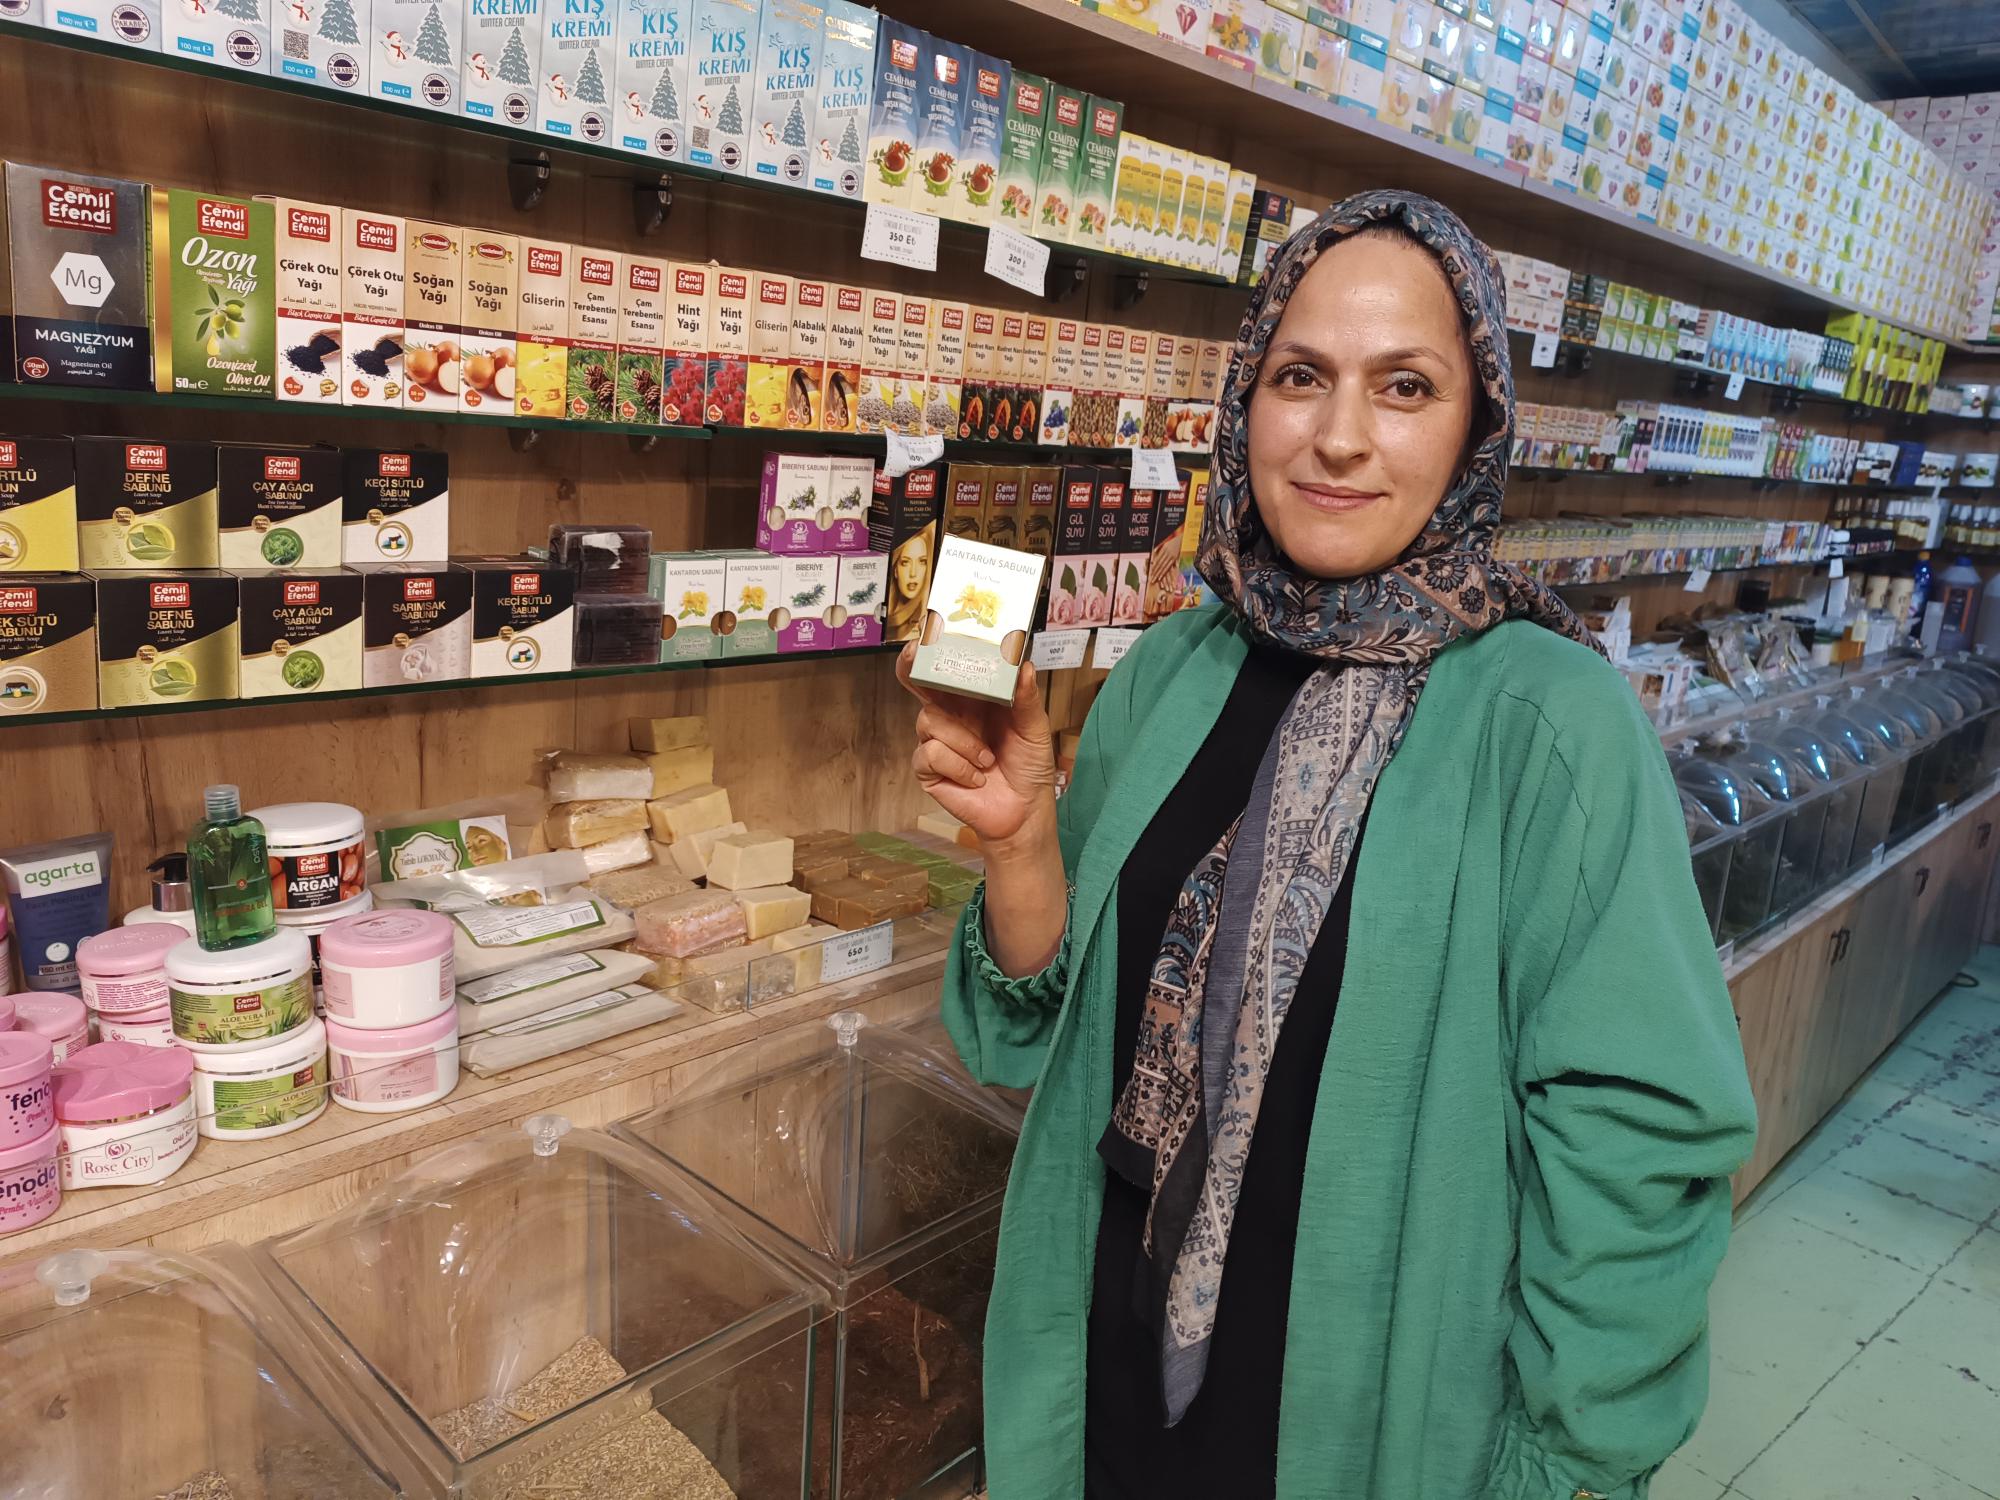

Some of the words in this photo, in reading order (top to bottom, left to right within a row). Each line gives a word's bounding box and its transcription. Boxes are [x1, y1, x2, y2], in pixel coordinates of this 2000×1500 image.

[504, 17, 525, 26] CREAM
[642, 12, 678, 40] KIŞ
[229, 44, 258, 53] PARABEN
[711, 31, 746, 57] KIŞ
[778, 47, 810, 72] KIŞ
[330, 66, 357, 74] PARABEN
[48, 184, 110, 208] Cemil
[49, 203, 111, 225] Efendi
[201, 204, 244, 220] Cemil
[201, 216, 244, 232] Efendi
[292, 212, 327, 225] Cemil
[292, 222, 327, 236] Efendi
[360, 222, 393, 236] Cemil
[360, 233, 393, 246] Efendi
[889, 231, 903, 242] 350
[182, 237, 257, 277] Ozon
[530, 249, 559, 263] Cemil
[280, 259, 315, 273] Çörek
[317, 264, 339, 276] Otu
[530, 259, 560, 272] Efendi
[584, 260, 611, 273] Cemil
[348, 265, 381, 280] Çörek
[383, 270, 404, 282] Otu
[583, 270, 611, 282] Efendi
[633, 267, 658, 279] Cemil
[678, 272, 703, 283] Cemil
[65, 268, 102, 294] Mg
[226, 272, 256, 297] Yağı
[297, 278, 322, 291] Yağı
[413, 272, 454, 288] Soğan
[632, 276, 658, 288] Efendi
[678, 280, 702, 291] Efendi
[721, 276, 745, 287] Cemil
[364, 284, 388, 297] Yağı
[468, 280, 508, 296] Soğan
[721, 284, 744, 296] Efendi
[763, 282, 785, 293] Cemil
[802, 285, 822, 296] Cemil
[419, 289, 447, 303] Yağı
[522, 293, 565, 308] Gliserin
[587, 292, 604, 302] Çam
[762, 290, 784, 301] Efendi
[840, 290, 860, 301] Cemil
[475, 297, 501, 311] Yağı
[573, 302, 617, 315] Terebentin
[636, 299, 652, 308] Çam
[623, 309, 663, 320] Terebentin
[678, 304, 700, 317] Hint
[720, 307, 742, 319] Hint
[582, 315, 607, 326] Esansı
[631, 320, 655, 331] Esansı
[677, 318, 699, 332] Yağı
[755, 319, 788, 332] Gliserin
[793, 320, 826, 332] Alabalık
[720, 321, 741, 334] Yağı
[832, 324, 863, 336] Alabalık
[873, 325, 893, 334] Keten
[35, 328, 134, 348] MAGNEZYUM
[801, 332, 817, 344] Yağı
[903, 329, 923, 339] Keten
[941, 334, 960, 343] Keten
[839, 338, 855, 349] Yağı
[868, 335, 896, 346] Tohumu
[899, 340, 926, 350] Tohumu
[74, 345, 96, 355] YAĞI
[874, 347, 889, 358] Yağı
[937, 344, 962, 354] Tohumu
[904, 351, 919, 361] Yağı
[942, 355, 956, 365] Yağı
[61, 359, 100, 369] Magnesium
[101, 361, 113, 369] Oil
[207, 357, 256, 373] Ozonized
[226, 371, 252, 386] Olive
[253, 373, 271, 386] Oil
[130, 447, 163, 457] Cemil
[130, 456, 163, 465] Efendi
[268, 459, 297, 468] Cemil
[382, 456, 408, 464] Cemil
[268, 467, 297, 476] Efendi
[382, 463, 408, 472] Efendi
[0, 469, 37, 482] RTLÜ
[125, 473, 170, 484] DEFNE
[909, 472, 934, 483] Cemil
[123, 483, 172, 493] SABUNU
[253, 482, 277, 493] ÇAY
[279, 480, 313, 492] AĞACI
[365, 478, 389, 489] KEÇİ
[391, 477, 424, 488] SÜTLÜ
[908, 482, 933, 492] Efendi
[958, 481, 980, 493] Cemil
[996, 483, 1017, 494] Cemil
[1033, 483, 1053, 493] Cemil
[266, 491, 302, 500] SABUNU
[380, 489, 410, 497] SABUN
[1070, 485, 1090, 496] Cemil
[956, 491, 979, 502] Efendi
[995, 491, 1016, 502] Efendi
[1069, 513, 1083, 525] GÜL
[1101, 513, 1116, 525] GÜL
[1131, 513, 1149, 524] ROSE
[1066, 527, 1085, 538] SUYU
[1098, 527, 1117, 538] SUYU
[1129, 526, 1150, 537] WATER
[998, 560, 1037, 575] SABUNU
[407, 580, 432, 589] Cemil
[514, 576, 538, 584] Cemil
[154, 586, 186, 595] Cemil
[288, 584, 316, 593] Cemil
[407, 588, 432, 596] Efendi
[513, 583, 537, 591] Efendi
[154, 594, 186, 603] Efendi
[287, 592, 316, 601] Efendi
[497, 596, 520, 606] KEÇİ
[522, 595, 552, 605] SÜTLÜ
[392, 601, 446, 613] SARIMSAK
[511, 606, 539, 614] SABUN
[149, 610, 193, 621] DEFNE
[273, 608, 296, 620] ÇAY
[299, 606, 333, 618] AĞACI
[401, 611, 438, 621] SABUNU
[16, 614, 57, 627] SÜTÜ
[147, 620, 194, 630] SABUNU
[284, 616, 321, 626] SABUNU
[0, 627, 43, 637] ABUNU
[300, 856, 326, 865] Cemil
[300, 863, 326, 872] Efendi
[24, 861, 94, 887] agarta
[288, 876, 338, 893] ARGAN
[847, 947, 863, 957] 650
[221, 1016, 241, 1024] ALOE
[242, 1013, 264, 1021] VERA
[11, 1083, 50, 1111] feno
[84, 1161, 118, 1174] Rose
[123, 1155, 151, 1170] City
[0, 1166, 56, 1198] nodo
